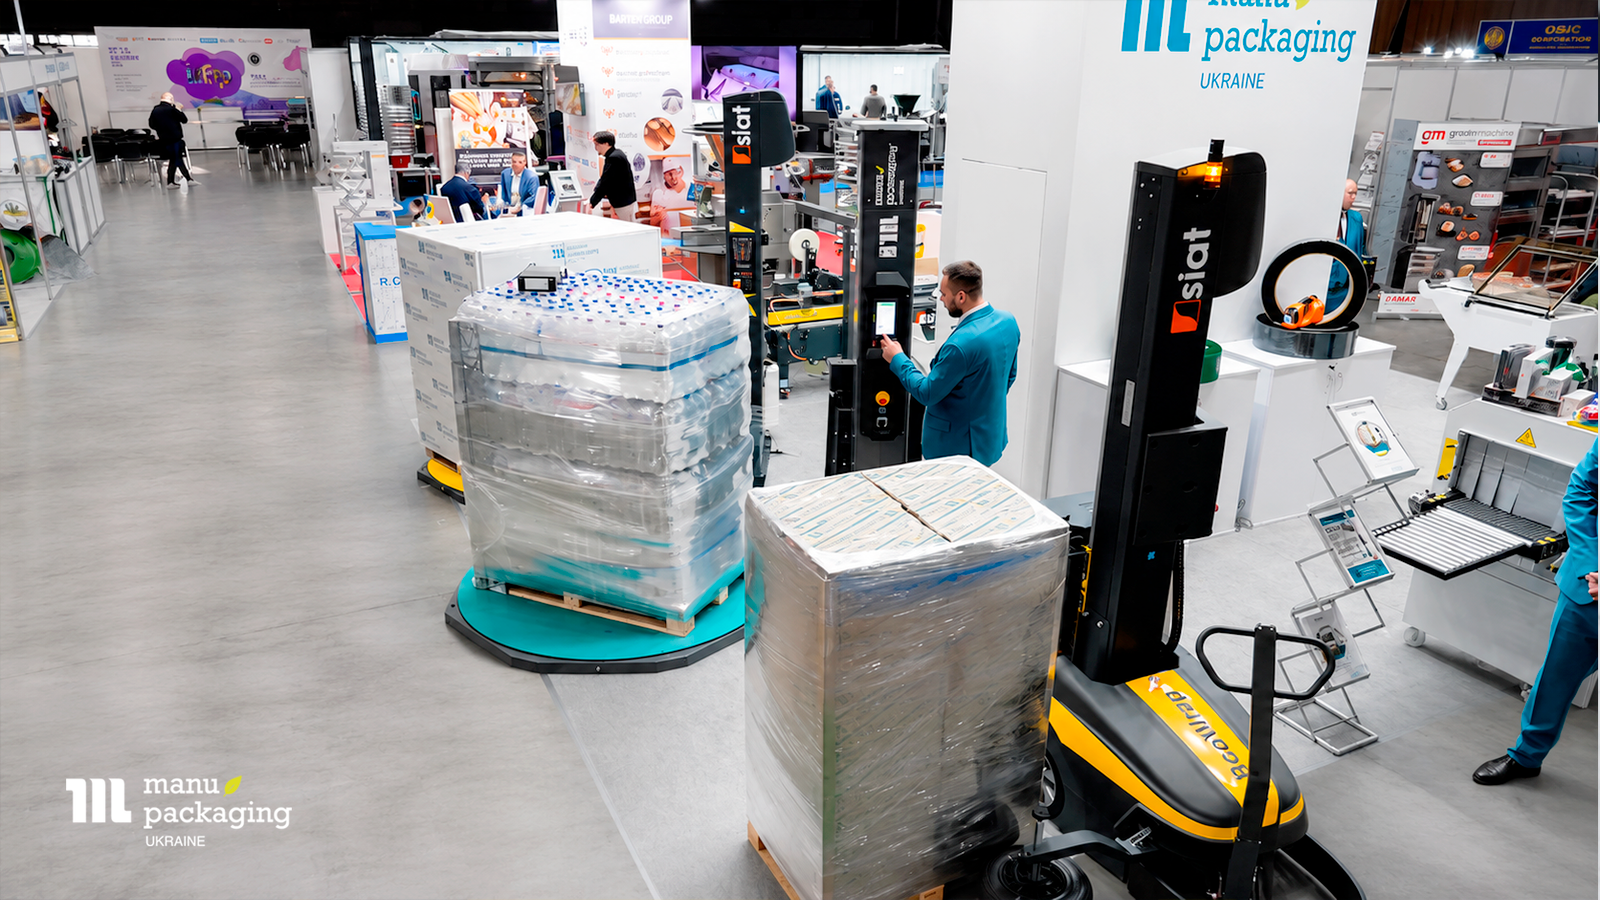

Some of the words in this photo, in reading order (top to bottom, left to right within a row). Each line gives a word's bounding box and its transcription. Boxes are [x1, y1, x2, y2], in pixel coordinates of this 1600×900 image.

[609, 13, 642, 24] BARTEN
[643, 14, 673, 25] GROUP
[1201, 19, 1356, 63] packaging
[1200, 72, 1265, 89] UKRAINE
[731, 105, 751, 146] siat
[1177, 227, 1212, 300] siat
[1385, 295, 1417, 303] DAMAR
